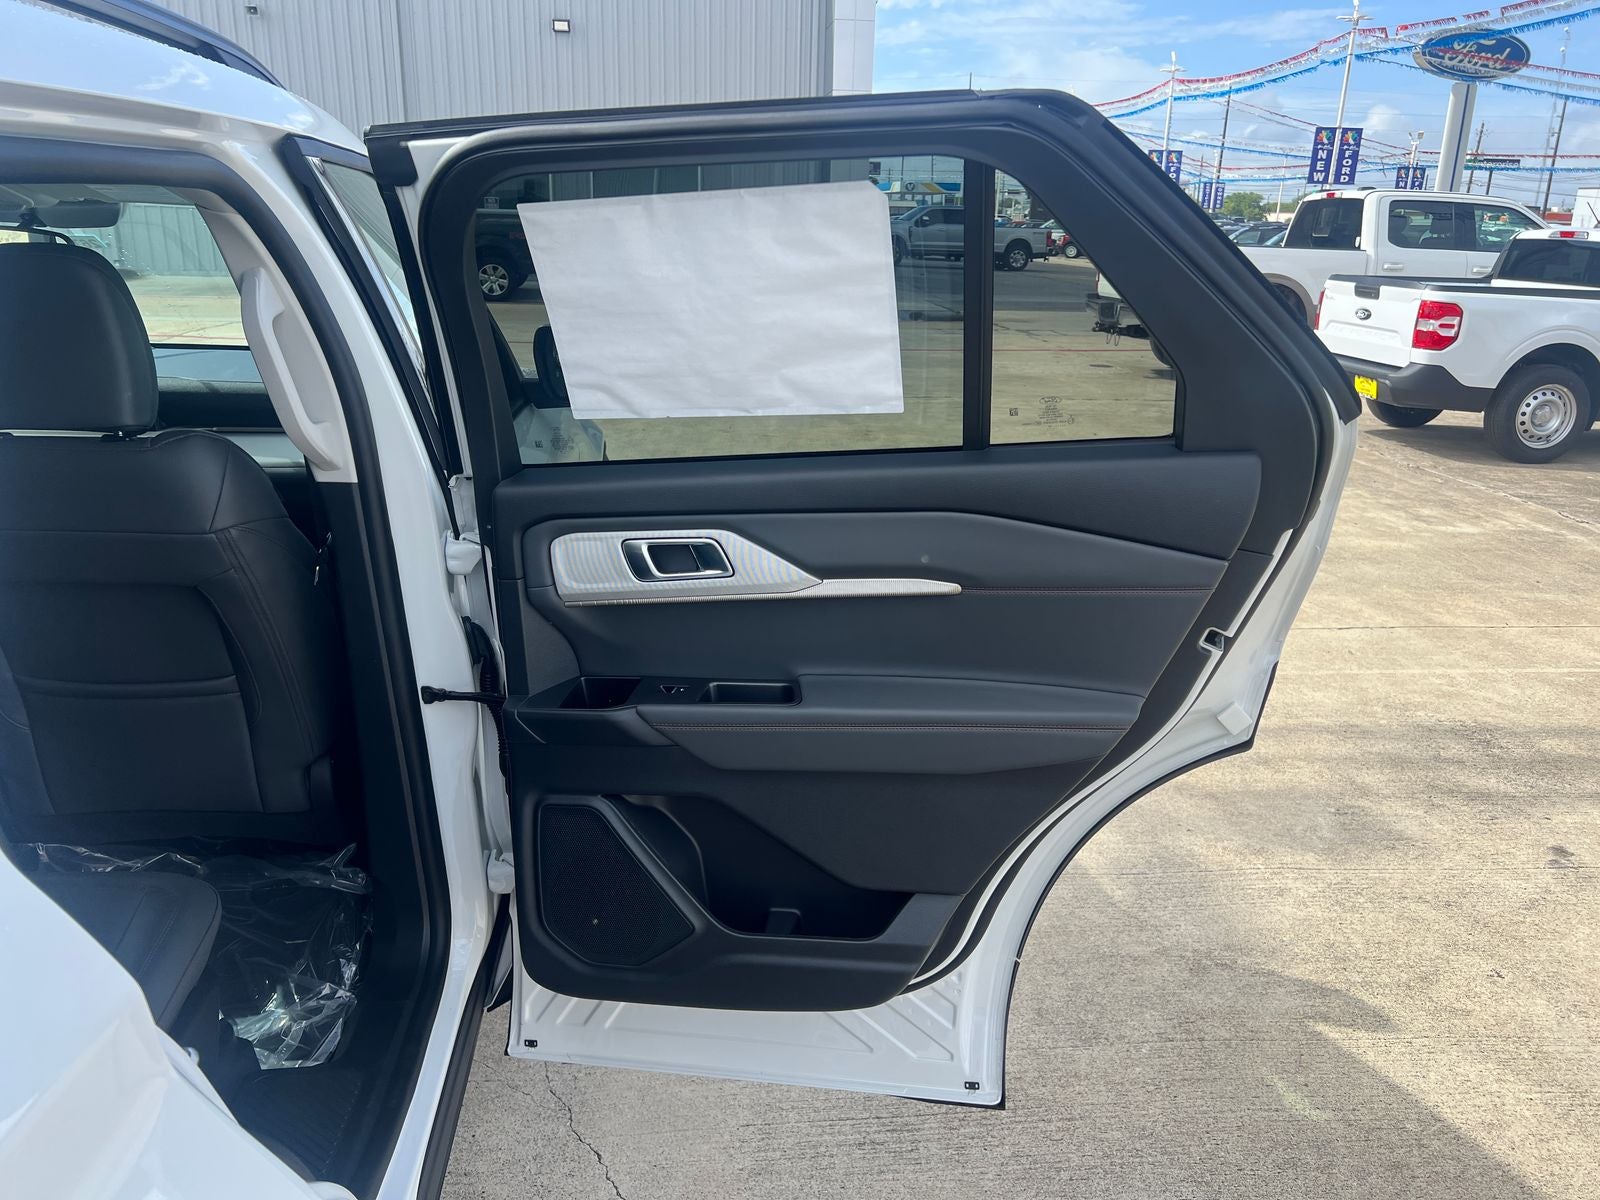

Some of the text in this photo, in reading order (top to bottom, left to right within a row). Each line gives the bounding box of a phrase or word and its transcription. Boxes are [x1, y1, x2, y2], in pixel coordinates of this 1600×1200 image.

[1444, 39, 1511, 69] Ford
[1313, 149, 1328, 182] NEW
[1340, 150, 1353, 183] FORD
